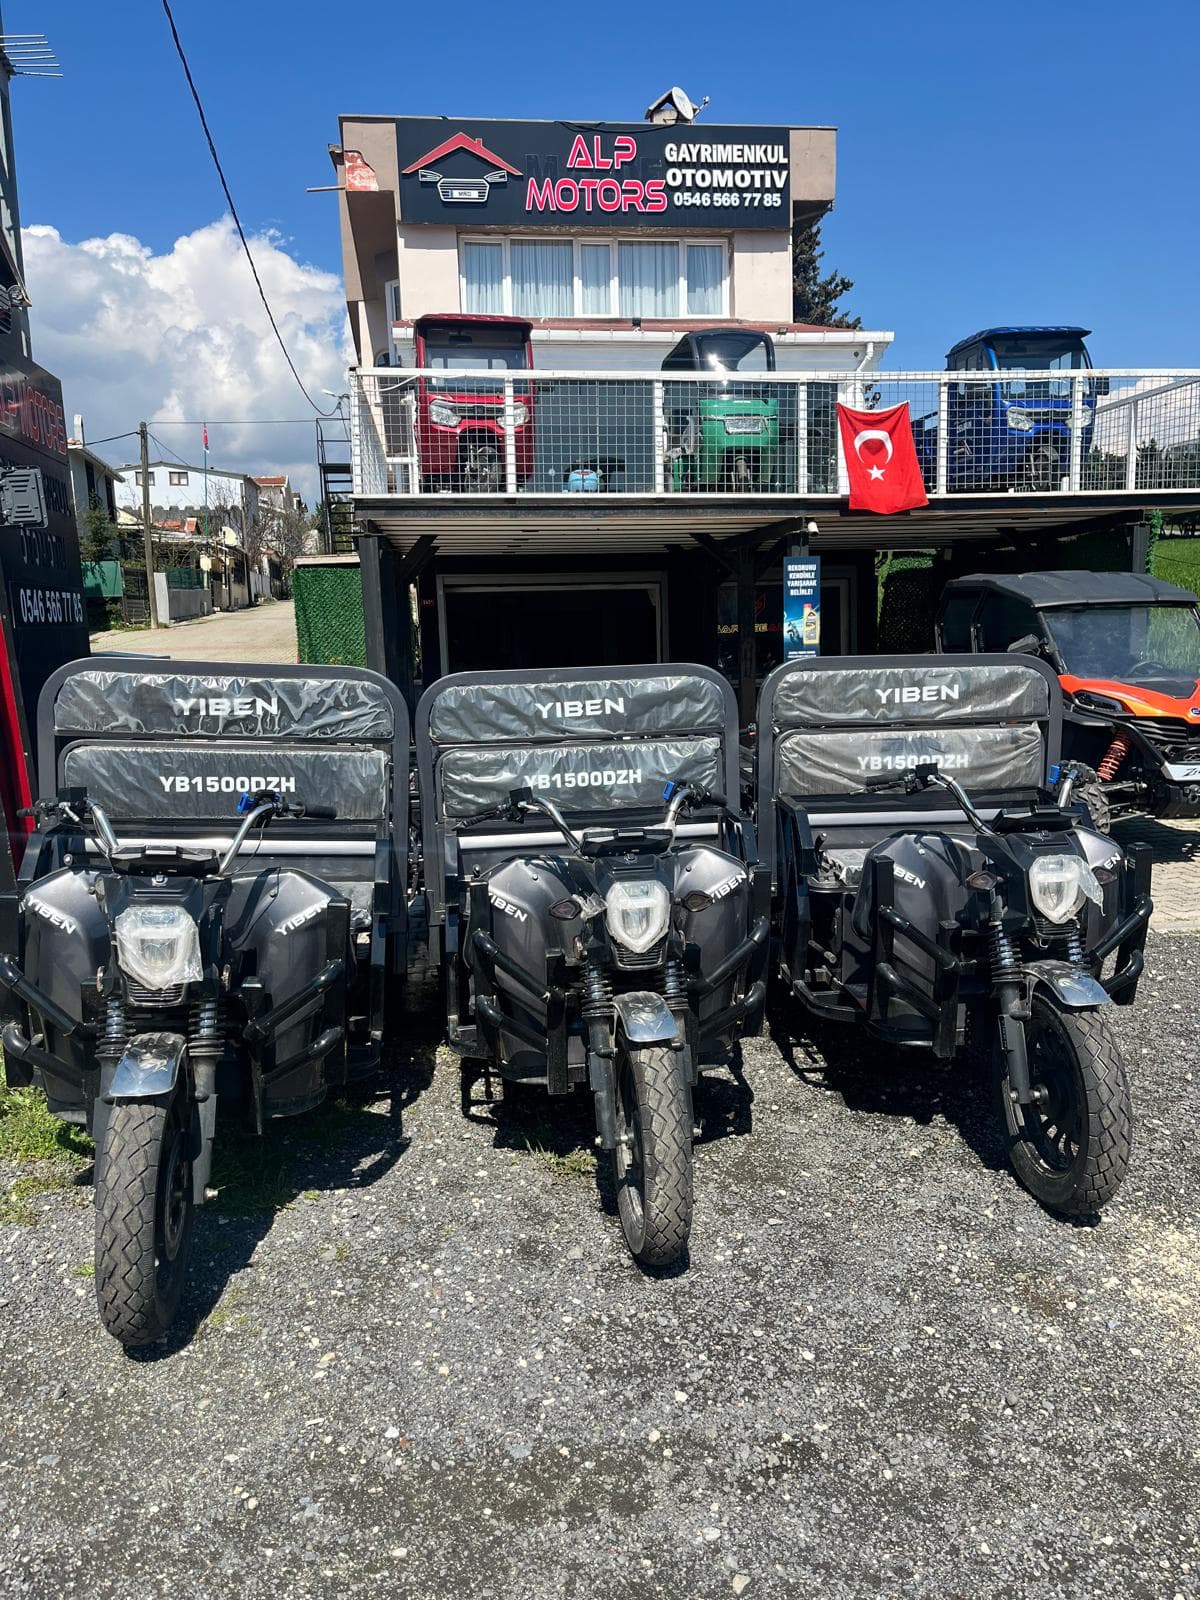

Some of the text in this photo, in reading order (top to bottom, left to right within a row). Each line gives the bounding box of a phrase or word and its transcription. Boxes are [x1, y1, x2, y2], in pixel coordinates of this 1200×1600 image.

[566, 134, 637, 169] ALP
[525, 177, 668, 212] MOTORS
[674, 192, 781, 207] 0546 566 77 85
[20, 588, 83, 623] 0546 566 77 85
[875, 684, 959, 704] YIBEN
[175, 698, 278, 716] YIBEN
[535, 698, 625, 719] YIBEN
[159, 776, 296, 793] YB1500DZH
[524, 769, 642, 789] YB1500DZH
[893, 863, 926, 888] BEN
[28, 895, 76, 934] YIBEN
[488, 892, 528, 922] IBEN
